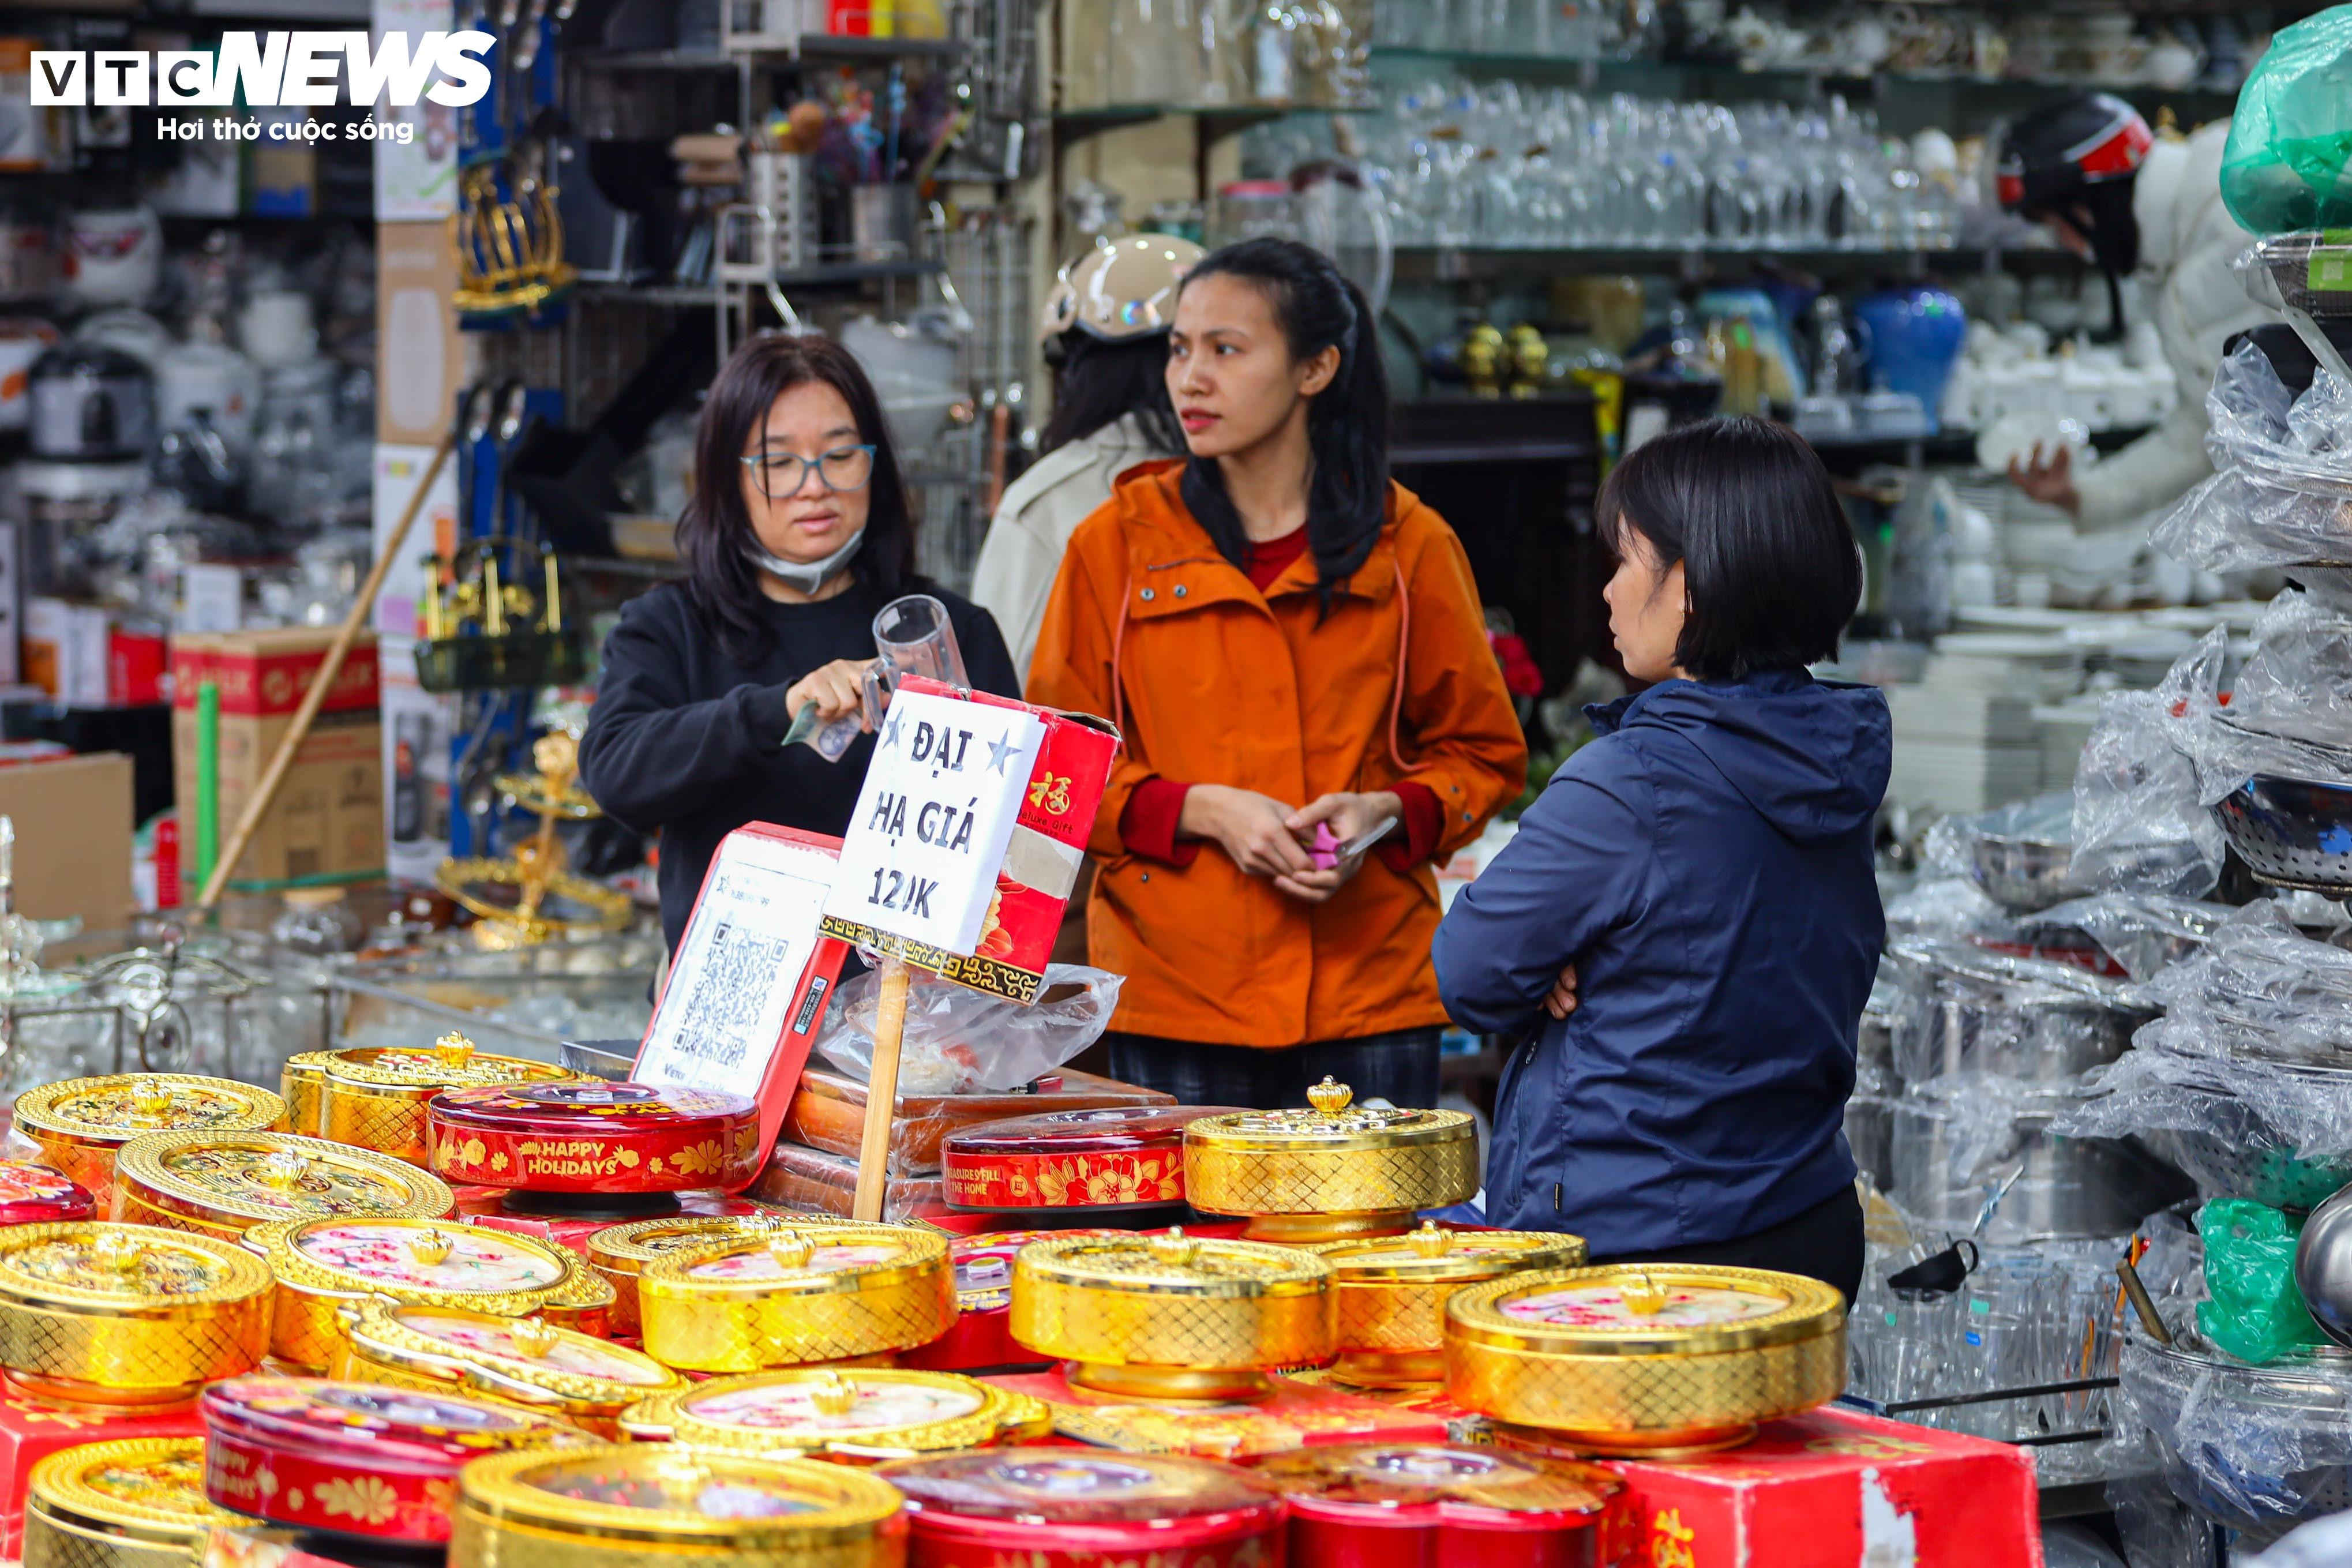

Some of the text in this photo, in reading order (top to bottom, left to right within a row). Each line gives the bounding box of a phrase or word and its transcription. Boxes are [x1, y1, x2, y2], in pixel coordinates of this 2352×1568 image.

[910, 721, 973, 778] ĐẠI
[868, 791, 978, 854] HẠ GIÁ
[1052, 820, 1073, 834] Gift
[542, 1141, 606, 1157] HAPPY
[528, 1159, 617, 1176] HOLIDAYS
[981, 1169, 1000, 1181] FILL
[951, 1181, 988, 1195] THE HOME
